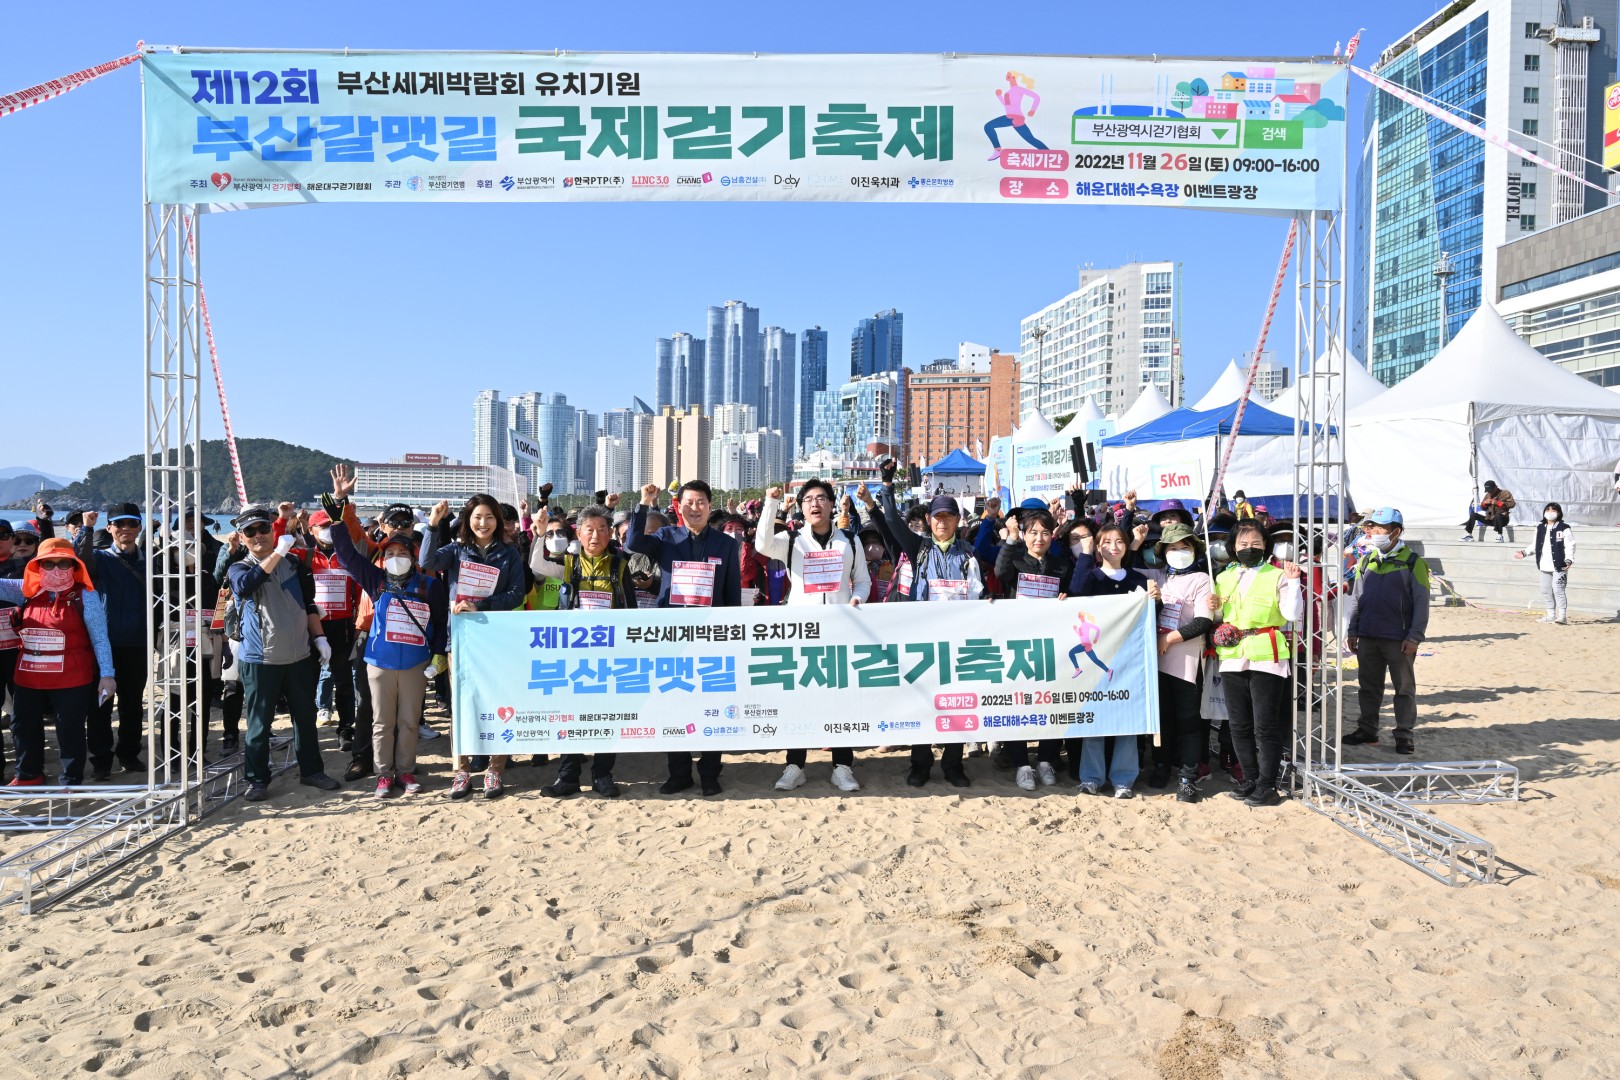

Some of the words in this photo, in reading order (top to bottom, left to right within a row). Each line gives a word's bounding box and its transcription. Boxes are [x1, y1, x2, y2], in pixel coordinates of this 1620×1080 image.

[191, 67, 320, 104] 제12회
[337, 70, 525, 96] 부산세계박람회
[535, 72, 640, 96] 유치기원
[192, 115, 497, 163] 부산갈맷길
[515, 103, 954, 161] 국제걷기축제
[1092, 124, 1201, 140] 부산광역시걷기협회
[1261, 127, 1287, 141] 검색
[1007, 152, 1063, 169] 축제기간
[1075, 154, 1124, 170] 2022년
[1127, 152, 1157, 170] 11월
[1160, 152, 1202, 172] 26일
[1204, 157, 1229, 172] (토)
[1233, 158, 1320, 172] 09:00-16:00
[190, 180, 207, 188] 주최
[385, 180, 401, 188] 주관
[477, 180, 493, 188] 후원
[517, 177, 555, 185] 부산광역시
[574, 176, 625, 186] 한국PTP(주)
[631, 176, 655, 184] LINC
[656, 176, 669, 184] 3.0
[851, 176, 900, 189] 이진욱치과
[233, 183, 271, 191] 부산광역시
[272, 183, 302, 191] 걷기협회
[307, 183, 372, 191] 해운대구걷기협회
[1076, 182, 1179, 197] 해운대해수욕장
[1184, 184, 1258, 200] 이벤트광장
[1507, 176, 1521, 221] HOTEL
[515, 438, 539, 459] 10Km
[1160, 472, 1191, 489] 5Km
[529, 624, 615, 649] 제12회
[626, 623, 746, 643] 부산세계박람회
[752, 622, 820, 641] 유치기원
[527, 655, 737, 695] 부산갈맷길
[748, 638, 1057, 691] 국제걷기축제
[938, 695, 974, 708] 축제기간
[981, 694, 1013, 706] 2022년
[1014, 692, 1033, 705] 11월
[1034, 691, 1060, 704] 26일
[1062, 693, 1077, 704] (토)
[1079, 689, 1130, 702] 09:00-16:00
[480, 713, 495, 721] 주최
[515, 714, 547, 722] 부산광역시
[548, 714, 575, 722] 걷기협회
[579, 713, 638, 721] 해운대구걷기협회
[704, 709, 719, 717] 주관
[983, 714, 1047, 727] 해운대해수욕장
[1050, 712, 1094, 725] 이벤트광장
[516, 729, 550, 737] 부산광역시
[567, 729, 614, 738] 한국PTP(주)
[620, 728, 643, 736] LINC
[644, 728, 656, 736] 3.0
[824, 722, 870, 734] 이진욱치과
